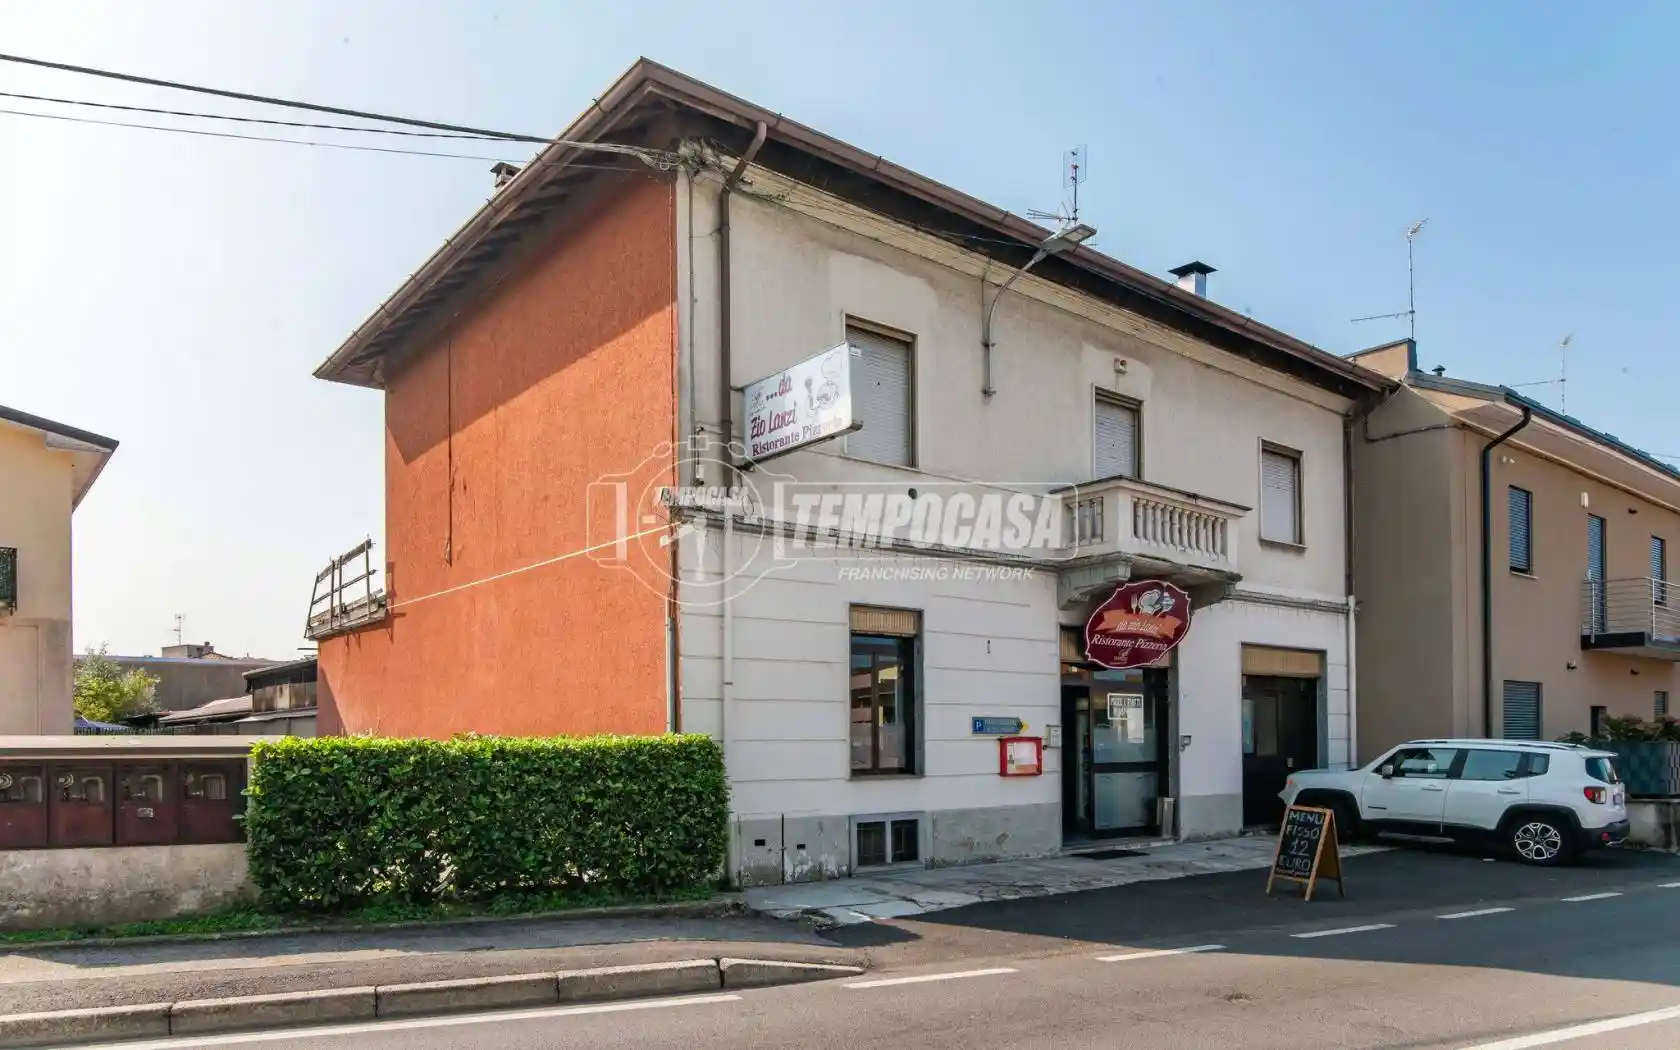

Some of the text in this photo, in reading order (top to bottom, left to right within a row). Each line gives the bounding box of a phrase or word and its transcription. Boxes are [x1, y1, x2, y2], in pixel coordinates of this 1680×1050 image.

[750, 401, 797, 441] Zio Lanzi
[752, 414, 843, 456] Ristorante Pizzi
[1091, 634, 1167, 650] Ristorante Pizzeria
[976, 720, 983, 731] P
[1289, 812, 1325, 825] MENU
[1286, 824, 1320, 840] FISSO
[1288, 838, 1310, 857] 12
[1279, 855, 1311, 872] EURO
